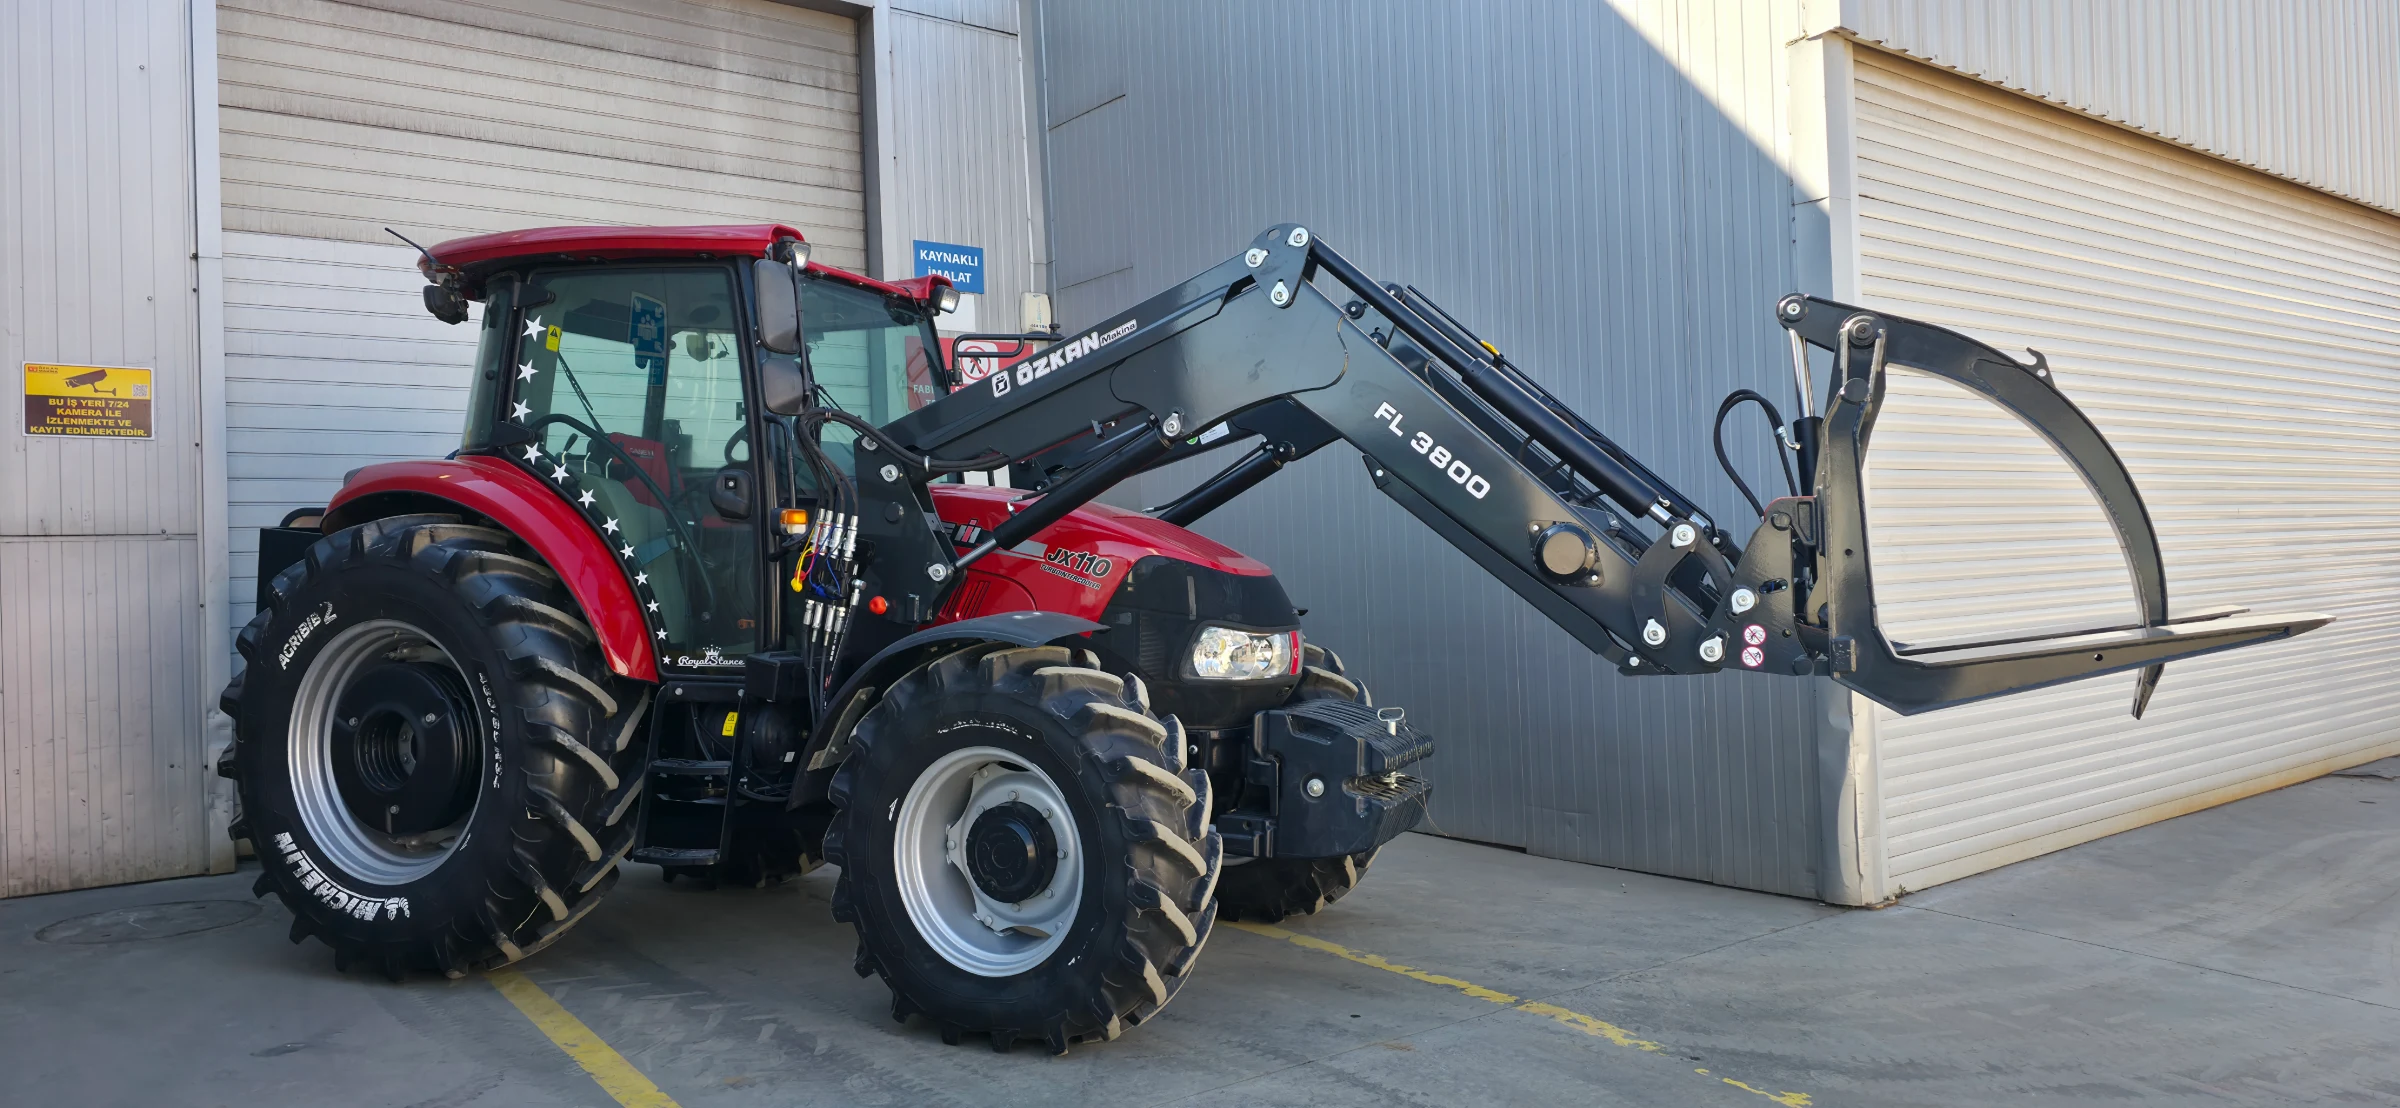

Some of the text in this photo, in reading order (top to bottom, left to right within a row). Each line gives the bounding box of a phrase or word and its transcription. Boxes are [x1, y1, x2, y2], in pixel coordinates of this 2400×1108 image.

[920, 249, 978, 266] KAYNAKLI
[1016, 331, 1100, 386] ÖZKAN
[1101, 322, 1136, 345] Makina
[48, 397, 130, 408] BU İŞ YERİ 7/24
[56, 408, 122, 417] KAMERA İLE
[46, 417, 132, 427] İZLENMEKTE VE
[30, 426, 148, 437] KAYIT EDİLMEKTEDİR.
[1373, 401, 1491, 499] FL 3800
[319, 601, 338, 625] 2
[273, 831, 383, 922] MICHELIN
